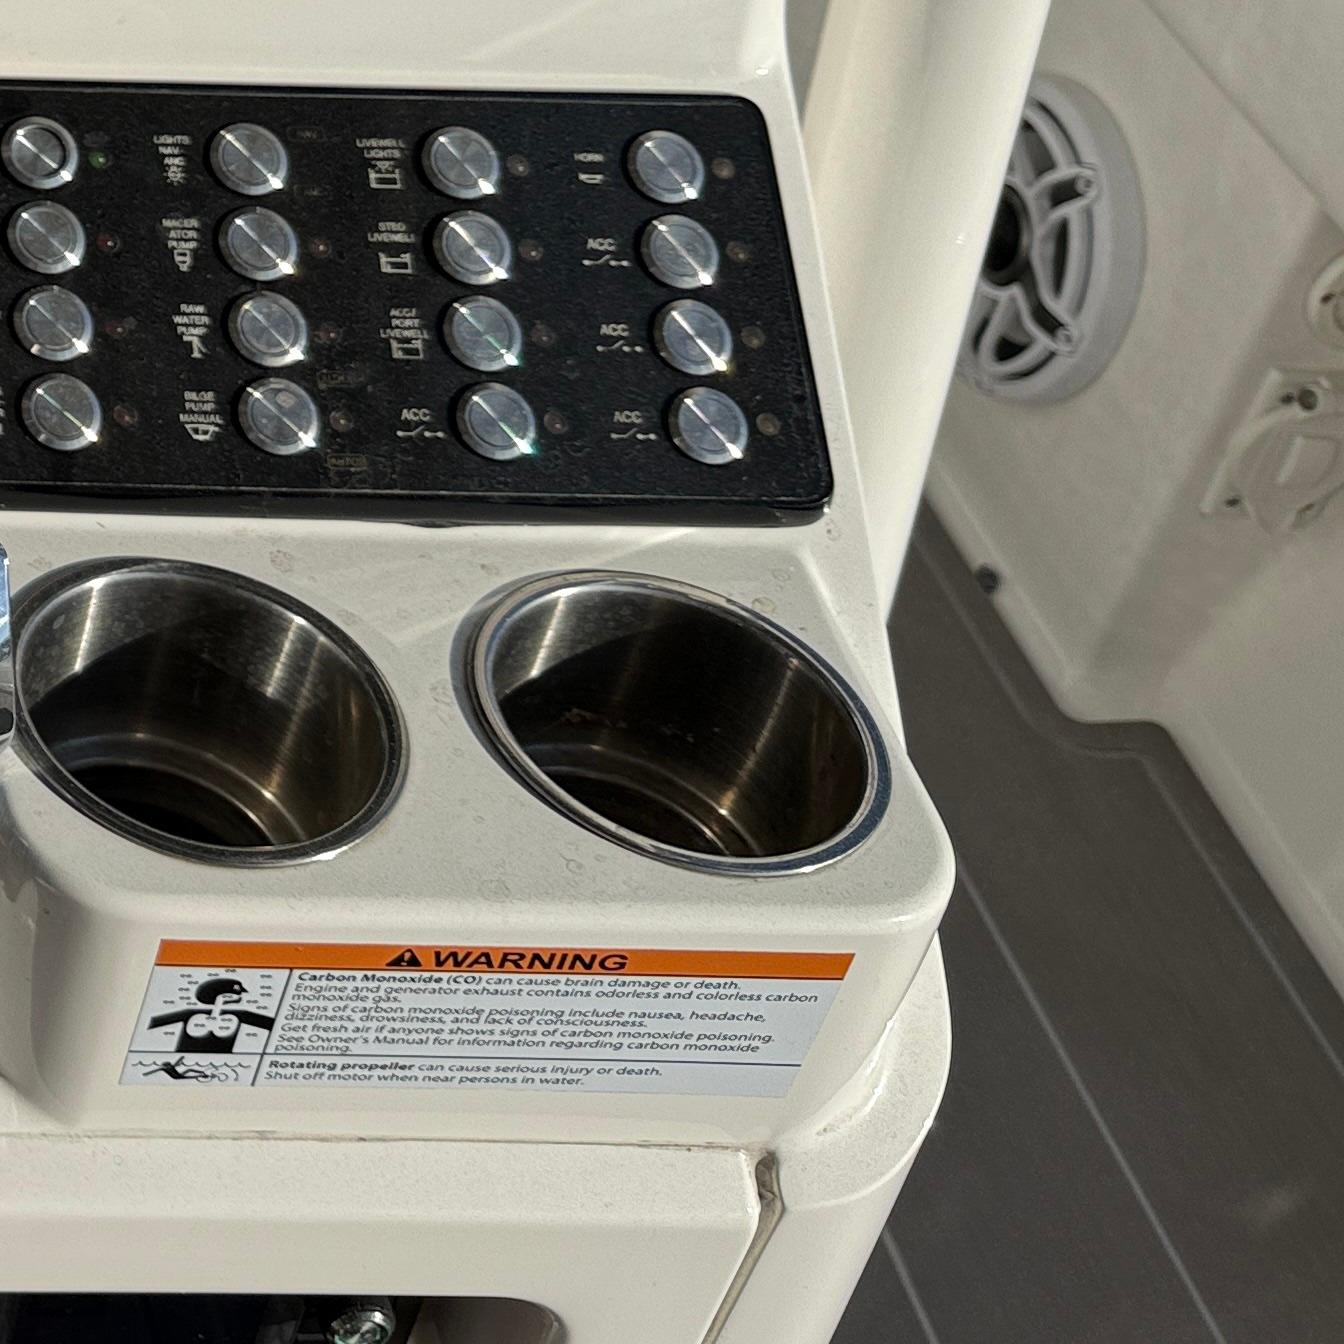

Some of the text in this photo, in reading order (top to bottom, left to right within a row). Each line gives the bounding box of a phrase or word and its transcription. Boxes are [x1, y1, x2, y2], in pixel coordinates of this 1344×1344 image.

[586, 238, 616, 252] ACC
[179, 303, 207, 314] RAW
[172, 314, 211, 325] WATER
[176, 325, 209, 336] PUMP
[599, 323, 630, 337] ACC
[184, 401, 216, 412] PUMP
[178, 412, 226, 425] MANUAL
[400, 407, 431, 421] ACC
[613, 410, 643, 424] ACC
[433, 950, 629, 971] WARNING
[298, 971, 742, 990] Carbon Monoxide (CO) can cause brain damage or death.
[291, 992, 402, 1004] monoxide gas.
[294, 983, 819, 1003] Engine and generator exhaust contains odorless and colorless carbon
[288, 1003, 766, 1022] Signs of carbon monoxide poisoning include nausea, headache,
[284, 1012, 648, 1028] dizziness, drowsiness, and lack of consciousness.
[280, 1022, 775, 1044] Get fresh air if anyone shows signs of carbon monoxide poisoning.
[274, 1044, 352, 1053] poisoning.
[277, 1033, 761, 1053] See Owner's Manual for information regarding carbon monoxide
[268, 1060, 663, 1077] Rotating propeller can cause serious injury or death.
[264, 1071, 584, 1086] Shut off motor when near persons in water.
